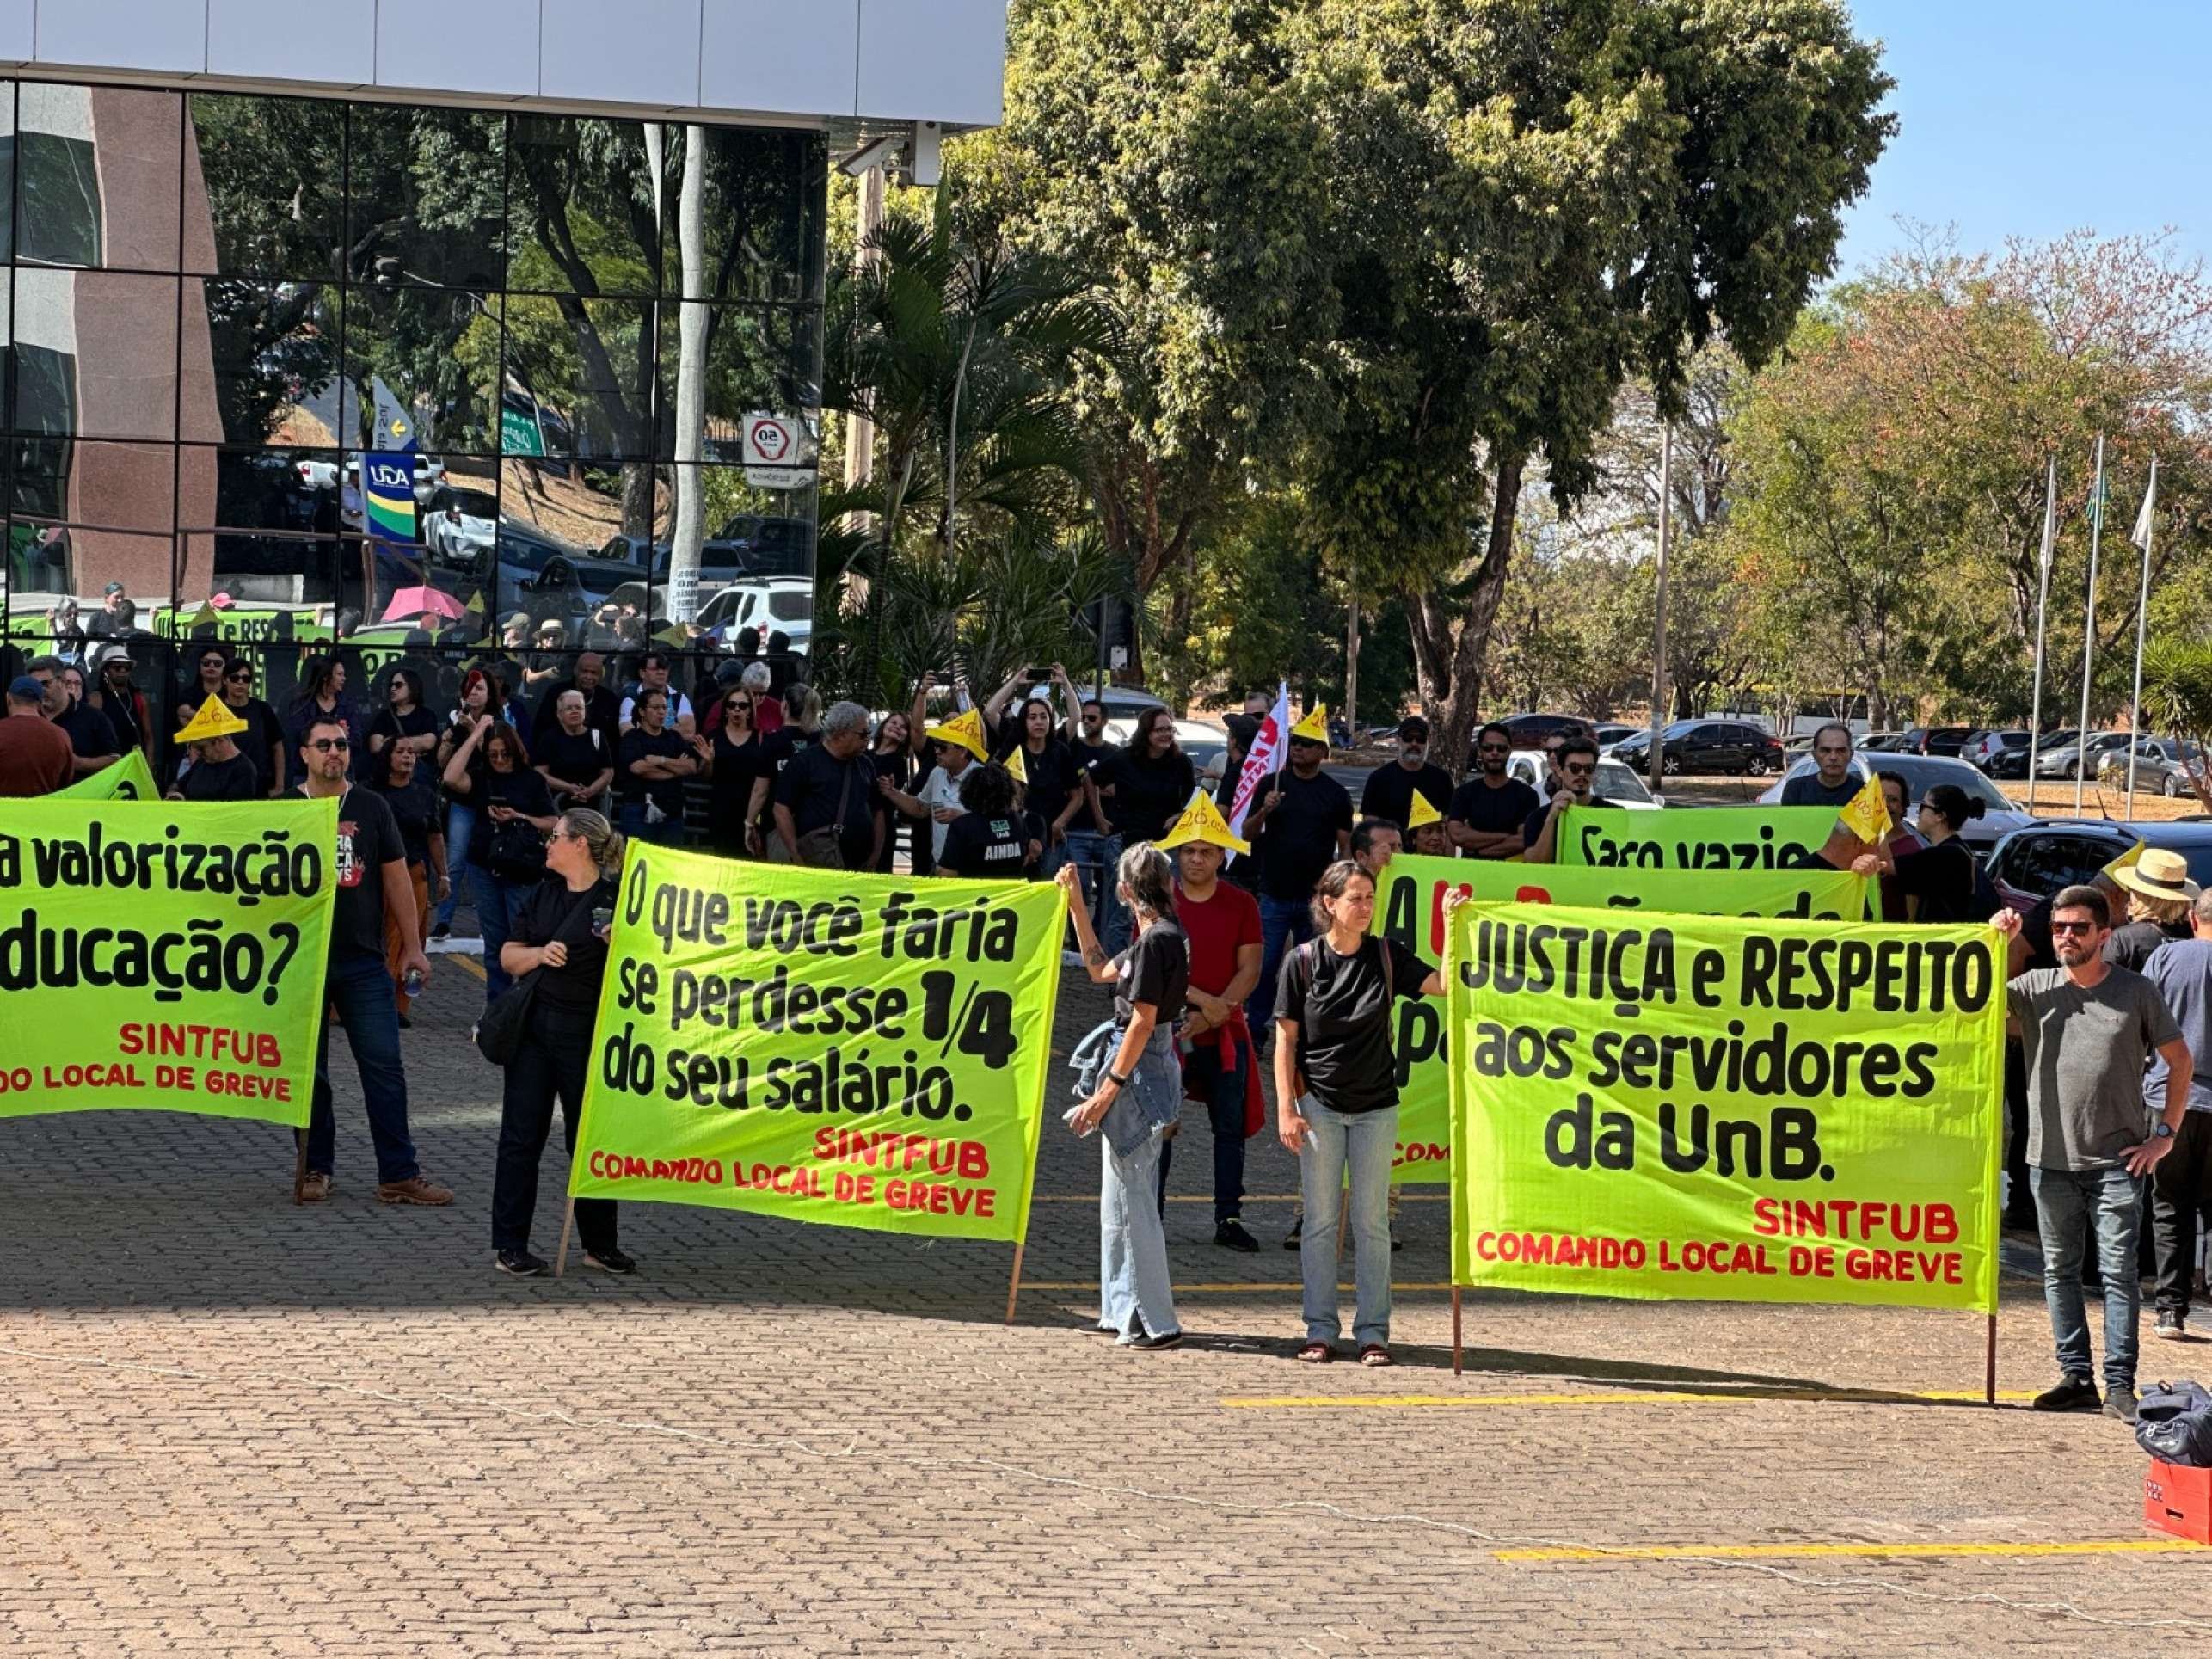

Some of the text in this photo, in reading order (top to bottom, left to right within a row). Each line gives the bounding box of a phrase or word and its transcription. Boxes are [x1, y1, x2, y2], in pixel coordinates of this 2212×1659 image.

[31, 821, 321, 905] valorização
[984, 842, 1021, 861] AINDA
[626, 858, 1018, 962] O que você faria
[1461, 920, 1992, 1017] JUSTIÇA e RESPEITO
[119, 1023, 281, 1067] SINTFUB
[618, 957, 1017, 1068] se perdesse 1/4
[44, 1064, 144, 1088] LOCAL
[156, 1066, 195, 1090] DE
[206, 1071, 291, 1102] GREVE
[604, 1021, 972, 1121] do seu salário.
[1475, 1019, 1939, 1098] aos servidores
[813, 1127, 989, 1178] SINTFUB
[1545, 1094, 1836, 1183] da UnB.
[590, 1150, 996, 1217] COMANDO LOCAL DE GREVE
[1754, 1198, 1959, 1242] SINTFUB
[1478, 1232, 1963, 1285] COMANDO LOCAL DE GREVE
